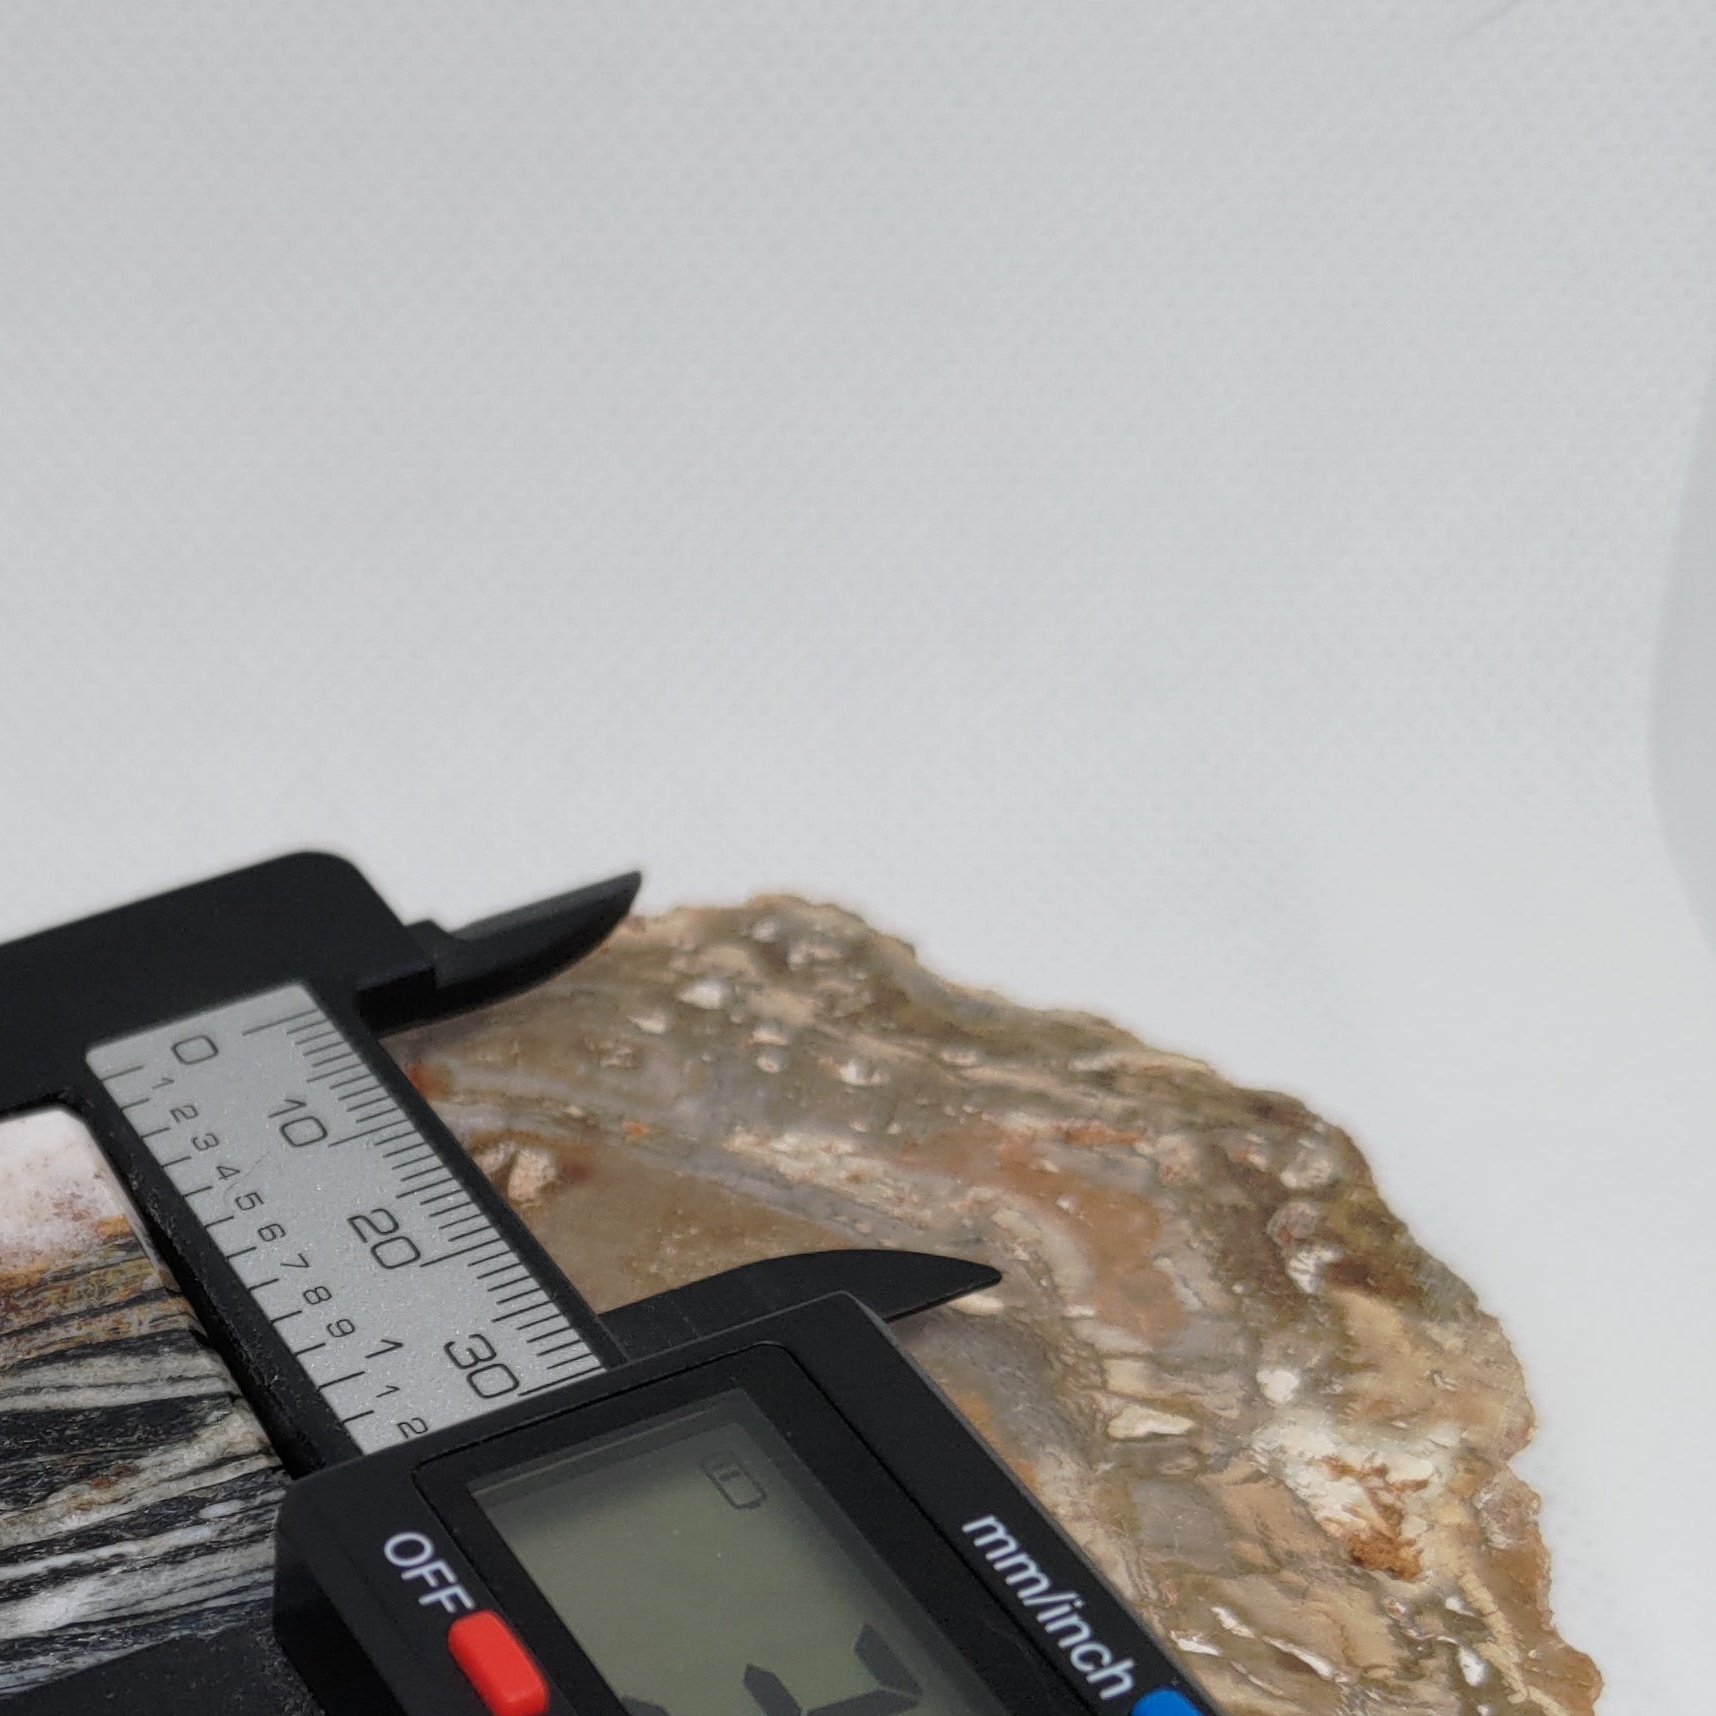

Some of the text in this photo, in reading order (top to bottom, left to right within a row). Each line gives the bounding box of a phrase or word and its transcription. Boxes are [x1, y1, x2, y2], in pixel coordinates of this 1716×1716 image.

[152, 1076, 428, 1438] 1 2 3 4 5 6 7 8 9 1 1 2
[171, 1036, 519, 1399] 0 10 20 30
[382, 1531, 475, 1615] OFF
[962, 1513, 1136, 1701] mm/inch
